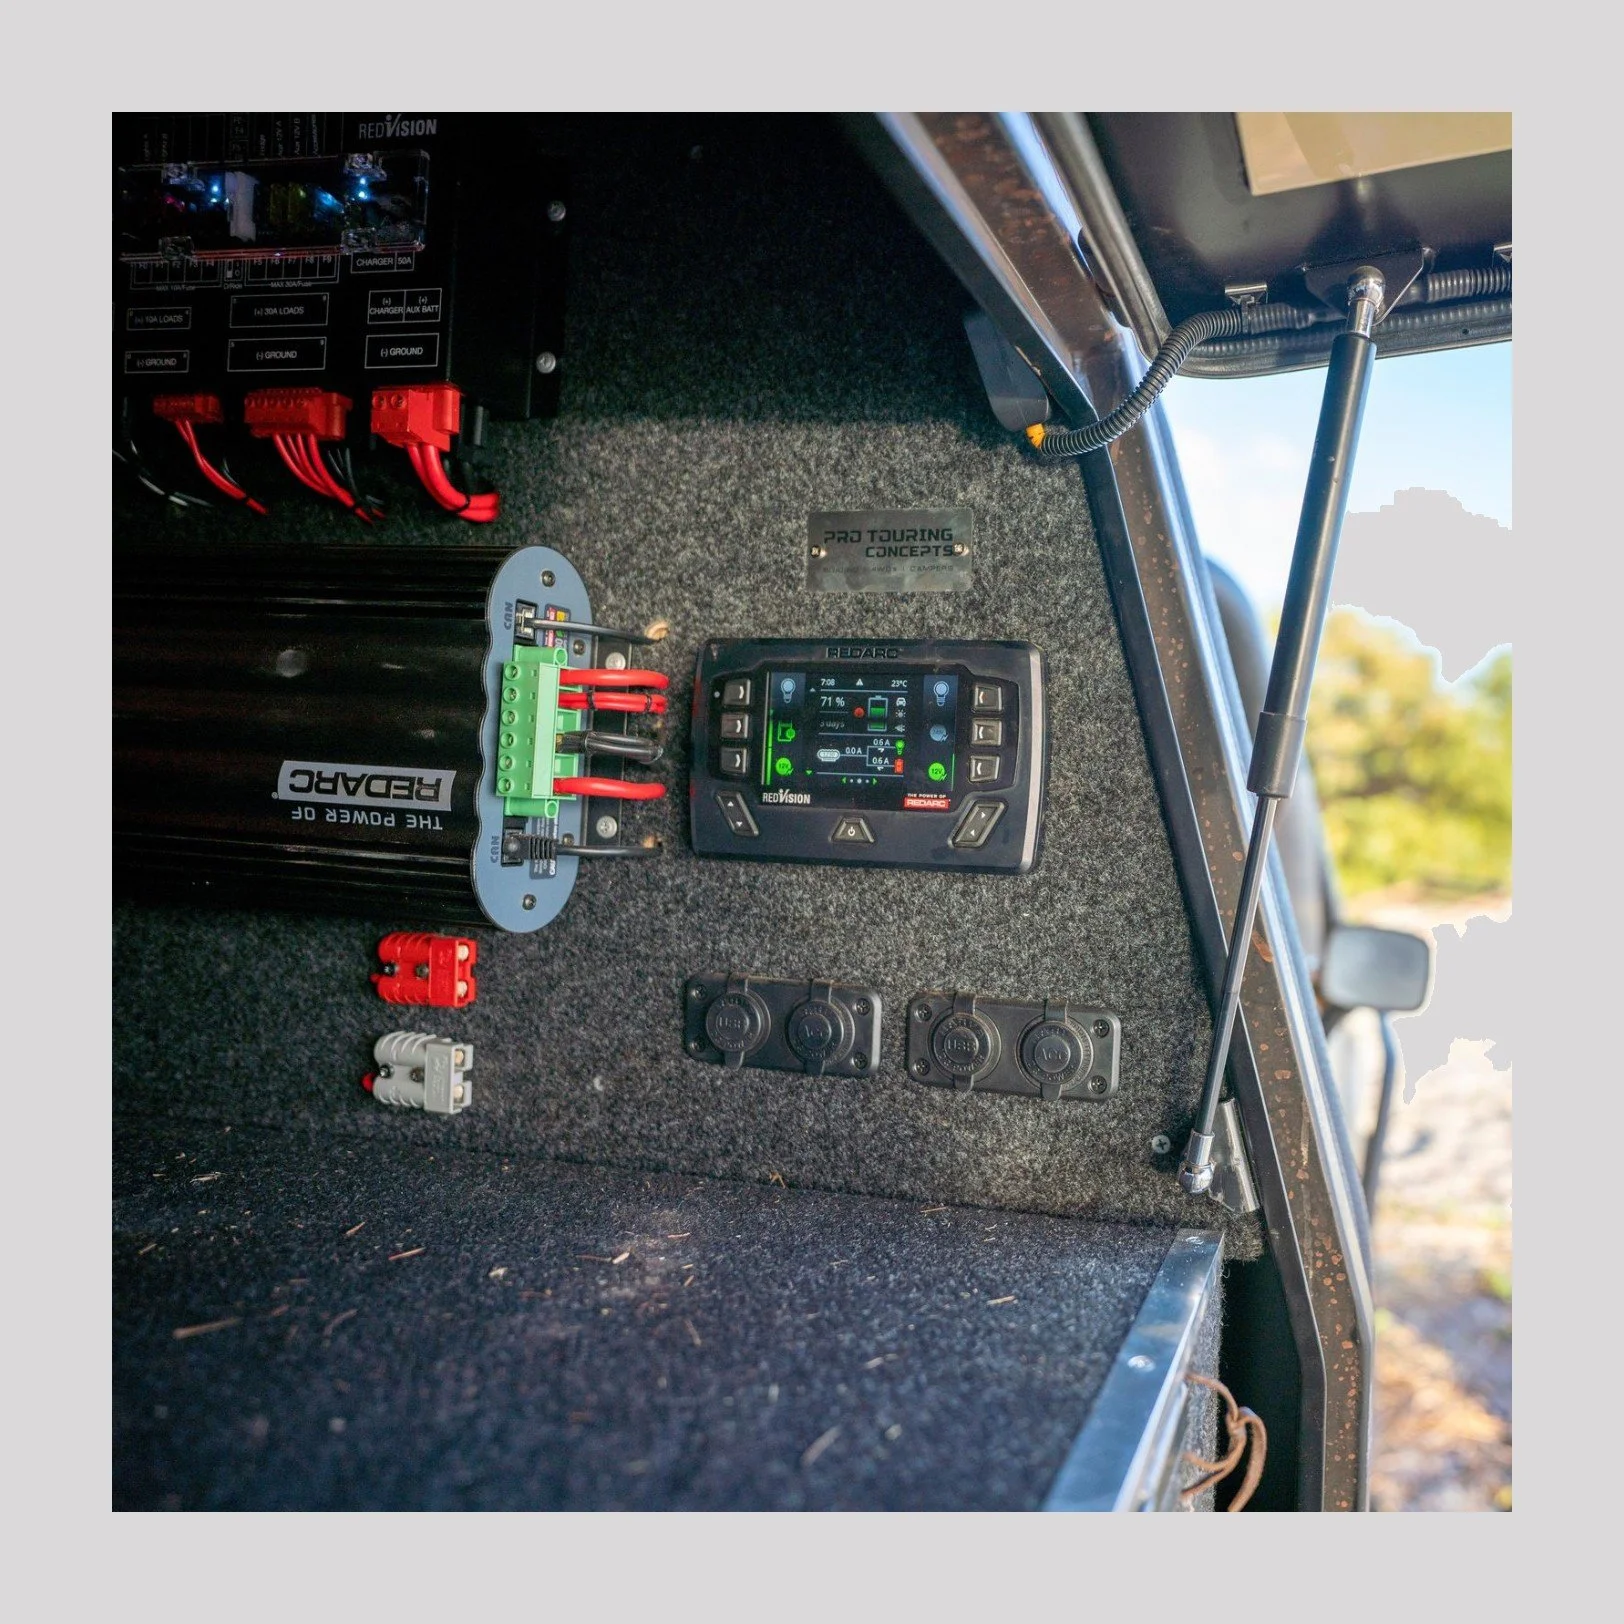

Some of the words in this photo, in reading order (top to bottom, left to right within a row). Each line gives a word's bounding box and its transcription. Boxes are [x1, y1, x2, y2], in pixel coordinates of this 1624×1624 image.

[356, 257, 394, 267] CHARGER
[397, 256, 412, 265] 50A
[278, 305, 305, 315] LOADS
[369, 306, 404, 315] CHARGER
[405, 305, 421, 314] AUX
[421, 304, 440, 313] BATT
[159, 313, 184, 324] LOADS
[264, 350, 298, 360] GROUND
[389, 347, 424, 357] GROUND
[145, 357, 178, 367] GROUND
[823, 530, 862, 544] PRO
[867, 528, 953, 543] TOURING
[865, 545, 954, 558] CONCEPTS
[503, 601, 514, 631] CAN
[825, 647, 899, 659] REDARC
[820, 696, 832, 708] 71
[835, 696, 846, 708] %
[873, 738, 884, 746] 0.6
[845, 747, 856, 755] 0.0
[872, 756, 883, 765] 0.6
[288, 769, 443, 803] REDARC
[906, 799, 947, 808] REDARC
[291, 806, 316, 821] OF
[325, 808, 396, 827] POWER
[405, 814, 444, 831] THE
[490, 834, 500, 864] CAN
[947, 1038, 977, 1051] USB
